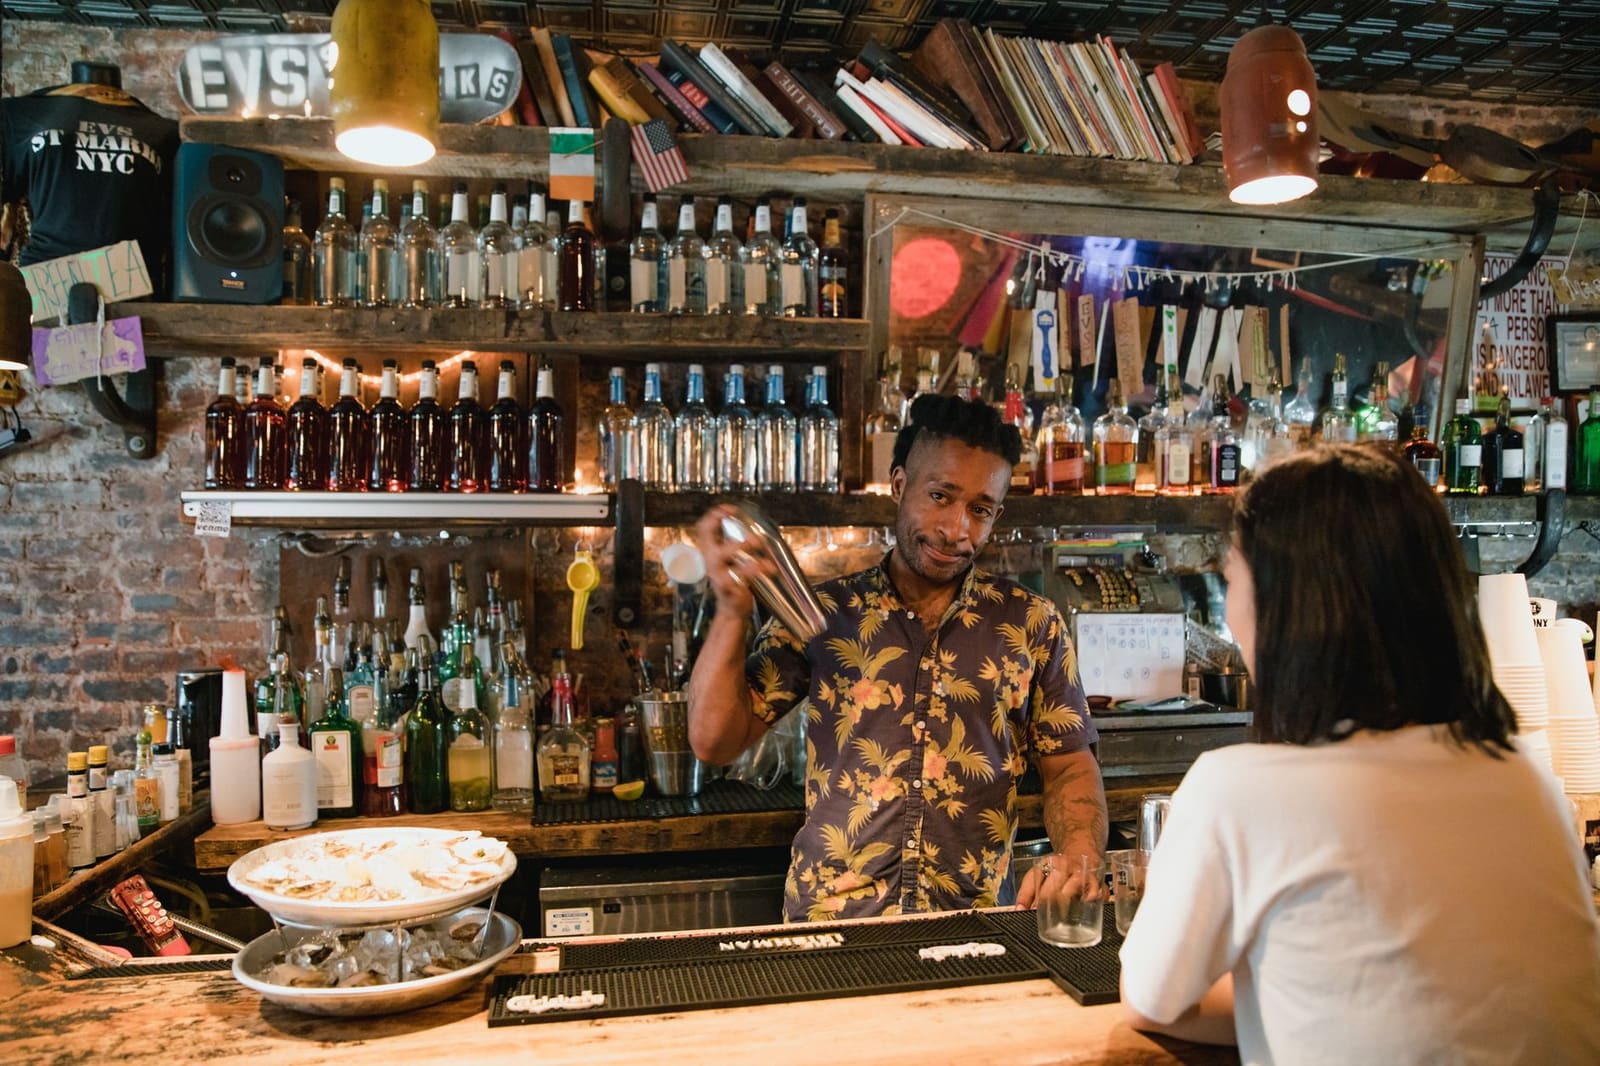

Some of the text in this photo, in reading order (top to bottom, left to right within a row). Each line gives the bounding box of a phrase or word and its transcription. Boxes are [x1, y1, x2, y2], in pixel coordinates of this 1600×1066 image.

[185, 46, 307, 110] EVS
[79, 120, 134, 136] EVS
[75, 150, 135, 175] NYC
[1494, 289, 1527, 314] MORE
